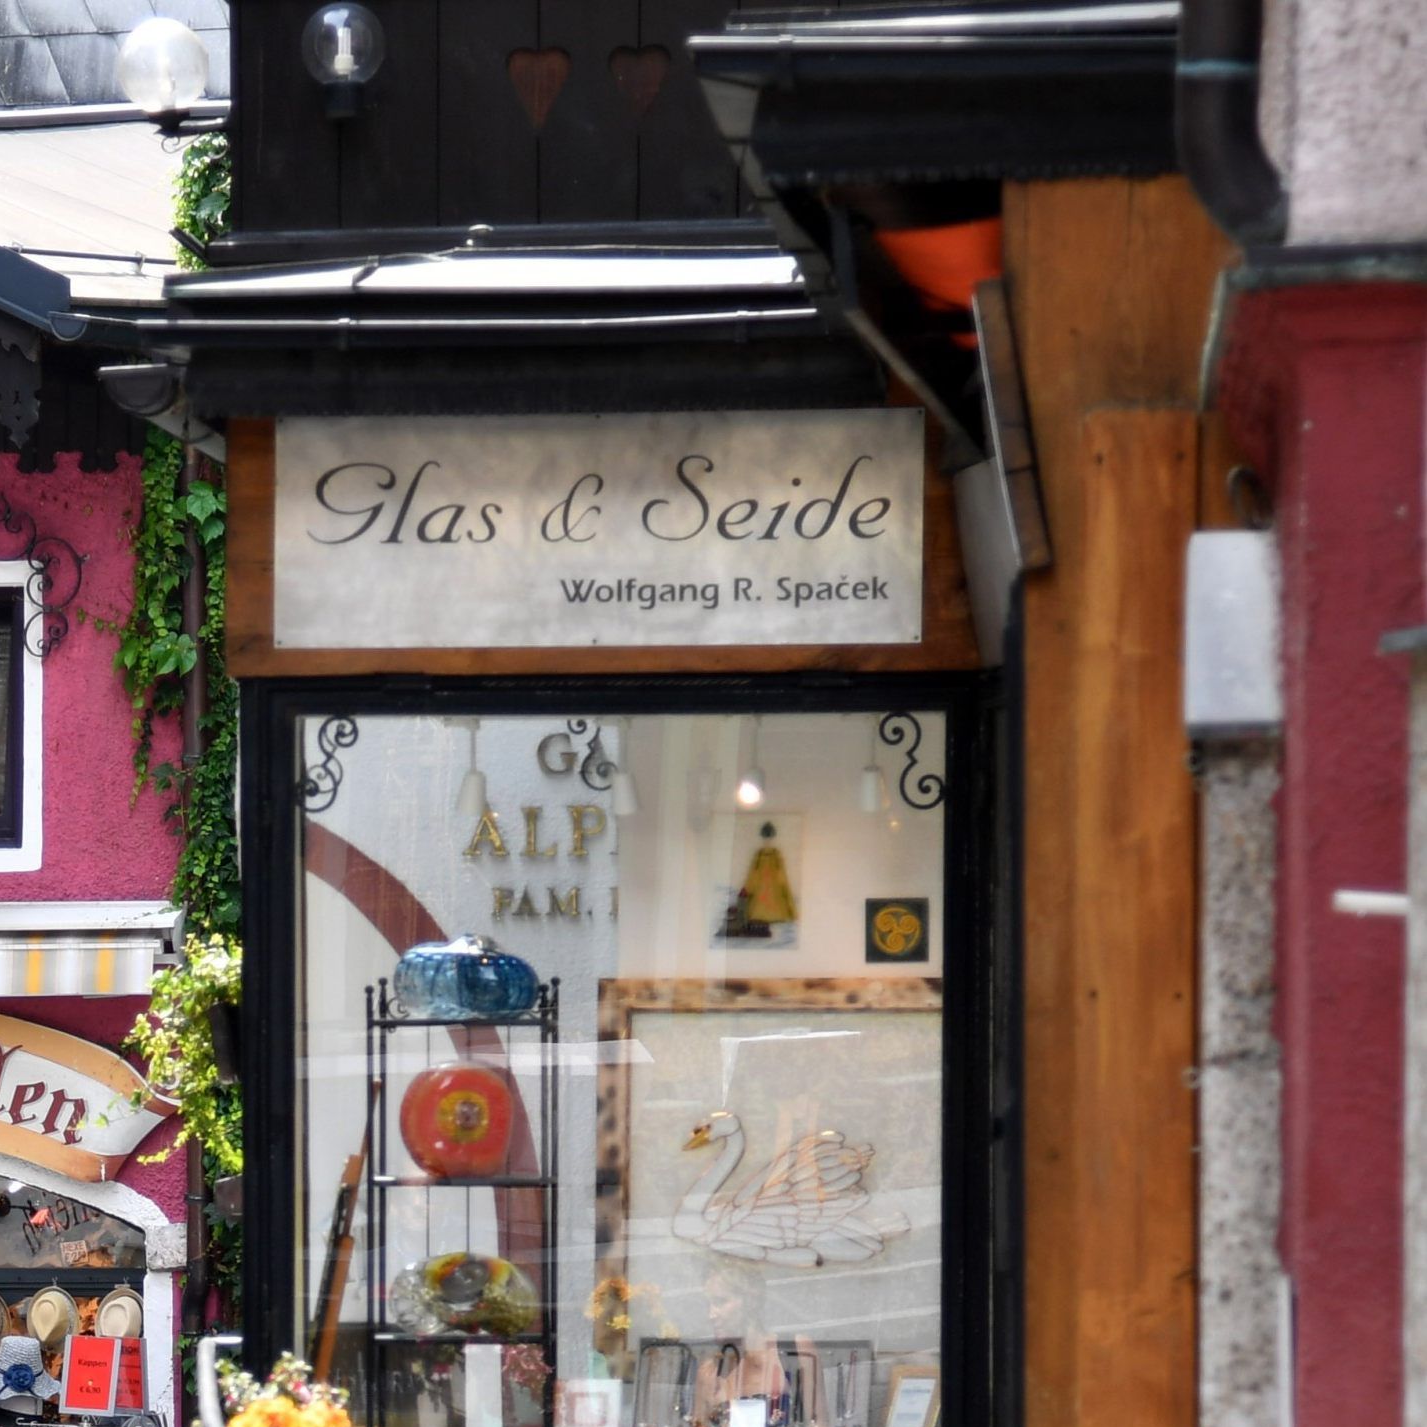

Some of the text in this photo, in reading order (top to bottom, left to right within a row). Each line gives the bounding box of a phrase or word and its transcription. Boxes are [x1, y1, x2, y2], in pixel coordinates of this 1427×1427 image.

[307, 455, 892, 545] Glas & Seide
[560, 575, 889, 610] Wolfgang R. Spaček
